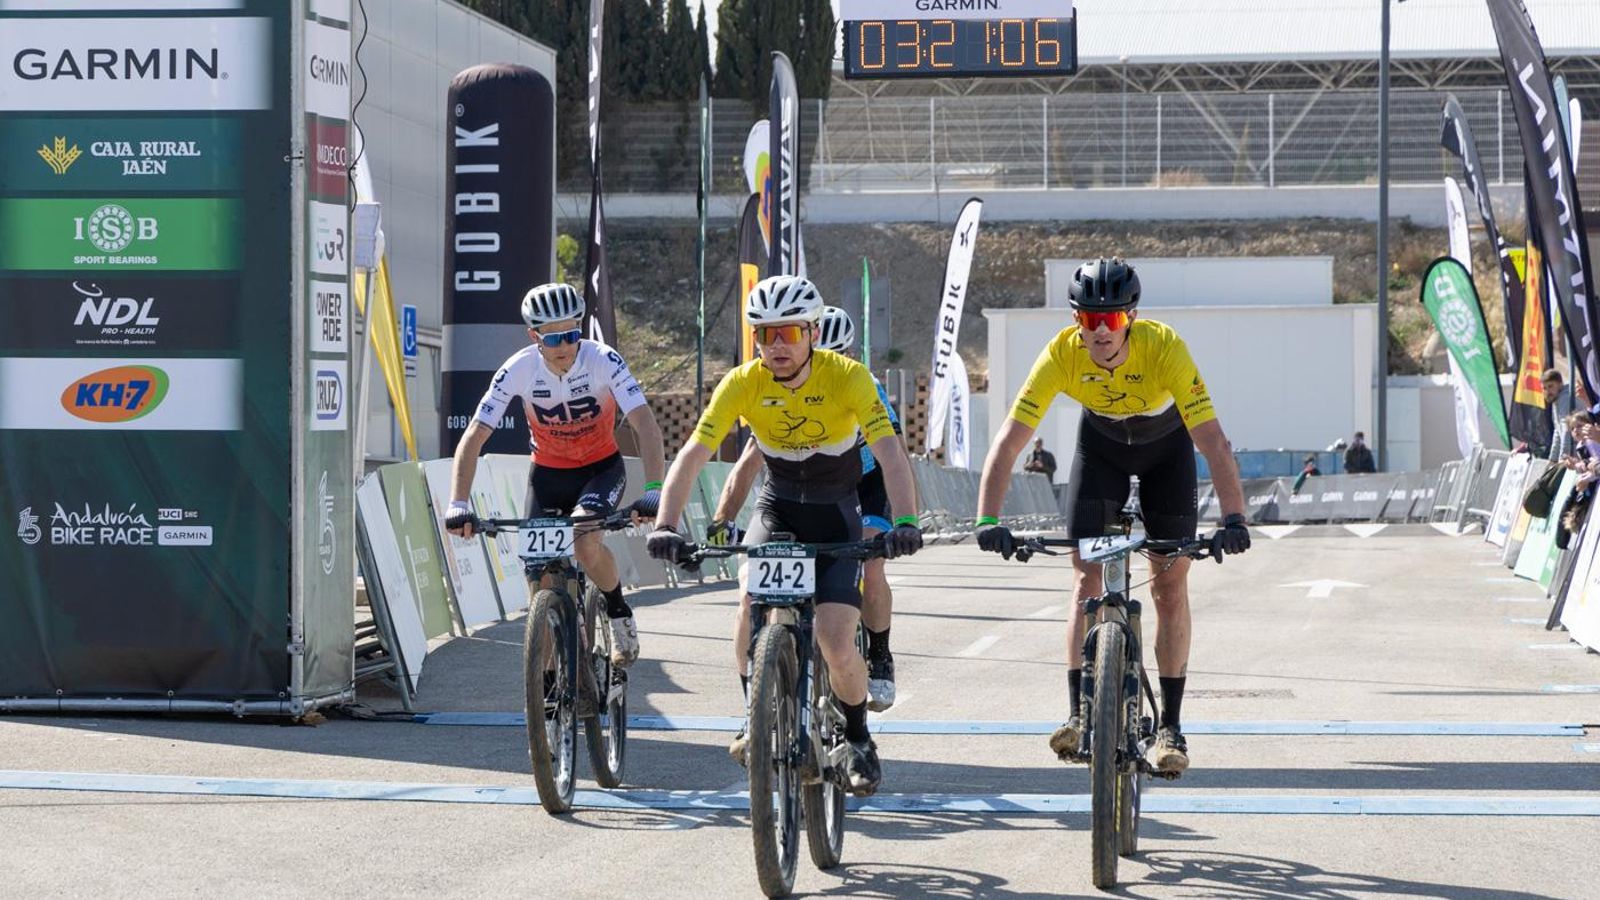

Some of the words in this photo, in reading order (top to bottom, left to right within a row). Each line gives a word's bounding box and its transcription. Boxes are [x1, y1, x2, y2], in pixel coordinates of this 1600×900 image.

[915, 0, 998, 11] GARMIN
[860, 19, 1060, 69] 03:21:06
[13, 48, 218, 80] GARMIN
[310, 55, 348, 86] GRMIN
[90, 141, 135, 157] CAJA
[140, 141, 201, 157] RURAL
[122, 157, 167, 175] JAÉN
[455, 122, 500, 291] GOBIK
[74, 255, 105, 264] SPORT
[109, 255, 158, 264] BEARINGS
[74, 297, 160, 325] NDL
[317, 292, 342, 316] OWER
[101, 327, 119, 335] PRO
[124, 327, 156, 335] HEALTH
[50, 502, 153, 527] Andalucía
[51, 527, 95, 545] BIKE
[100, 527, 153, 545] RACE
[164, 531, 207, 541] GARMIN
[527, 529, 565, 552] 21-2
[759, 561, 804, 588] 24-2
